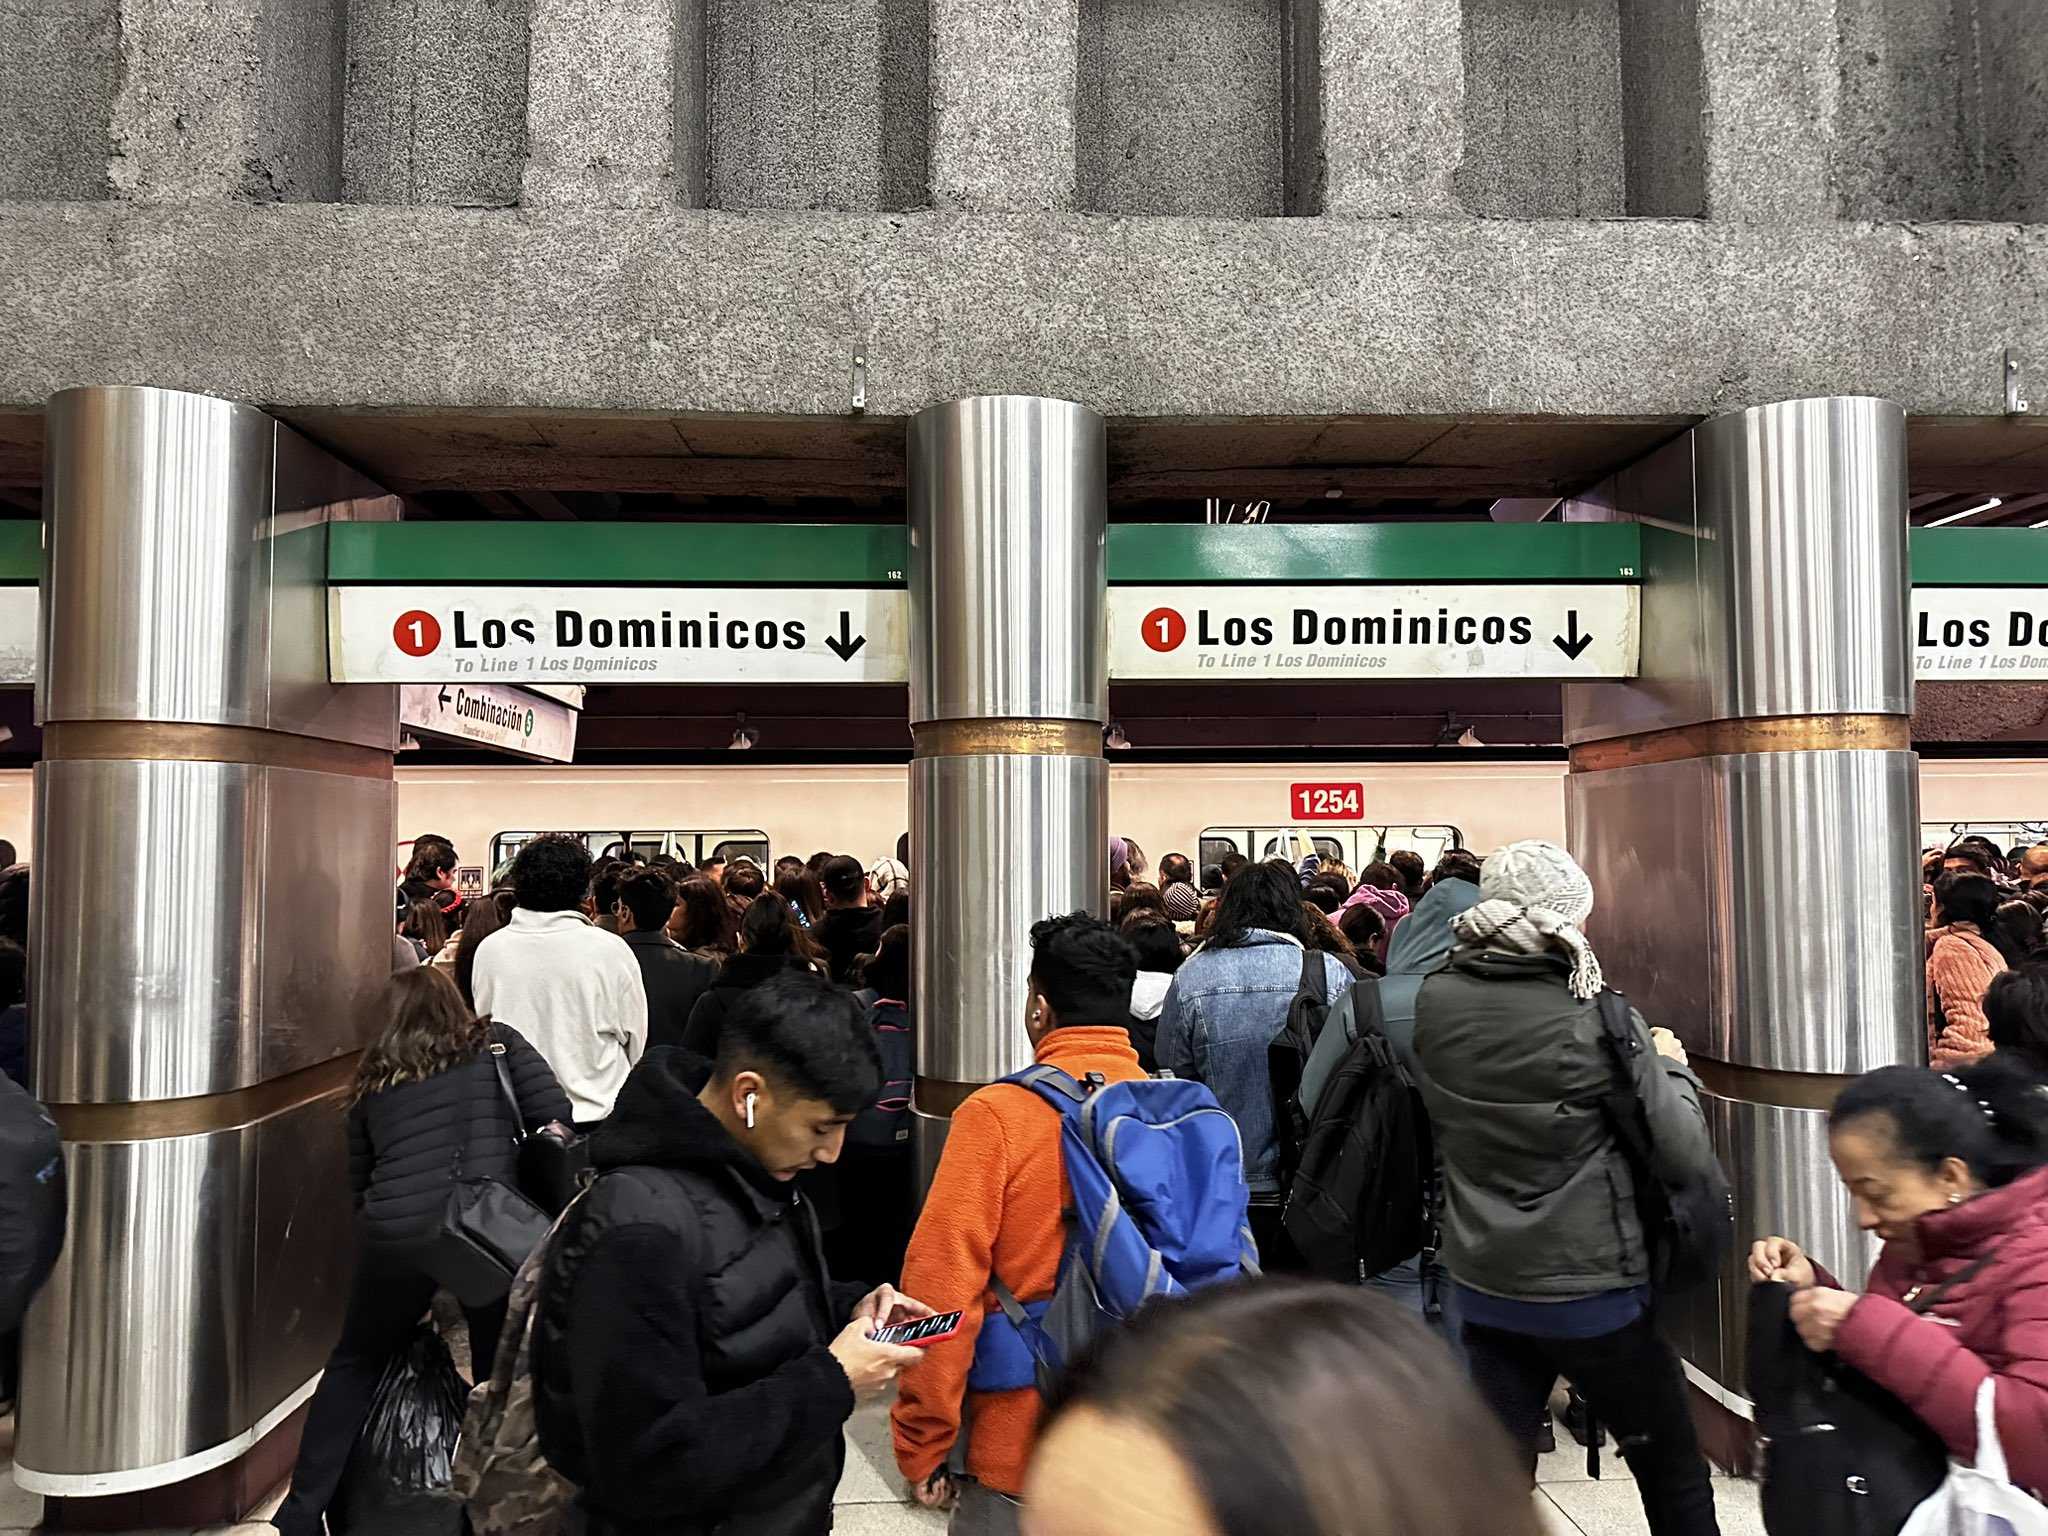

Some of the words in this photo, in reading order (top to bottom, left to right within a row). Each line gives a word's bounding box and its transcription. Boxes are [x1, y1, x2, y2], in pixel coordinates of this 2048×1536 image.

[888, 571, 902, 579] 162
[408, 620, 424, 648] 1
[555, 610, 806, 650] Dominicos
[1155, 617, 1169, 644] 1
[1198, 609, 1273, 646] Los
[1293, 608, 1532, 646] Dominicos
[1918, 611, 1990, 648] Los
[455, 658, 474, 673] To
[480, 655, 518, 672] Line
[526, 657, 535, 671] 1
[540, 656, 569, 671] Los
[572, 656, 659, 672] Dominicos
[1198, 653, 1216, 668] To
[1221, 653, 1257, 668] Line
[1263, 654, 1272, 668] 1
[1276, 653, 1303, 668] Los
[1306, 653, 1387, 669] Dominicos
[1916, 655, 1932, 670] To
[1938, 655, 1973, 670] Line
[1979, 655, 1987, 669] 1
[1990, 654, 2017, 669] Los
[456, 688, 522, 732] Combinación
[1299, 789, 1359, 814] 1254
